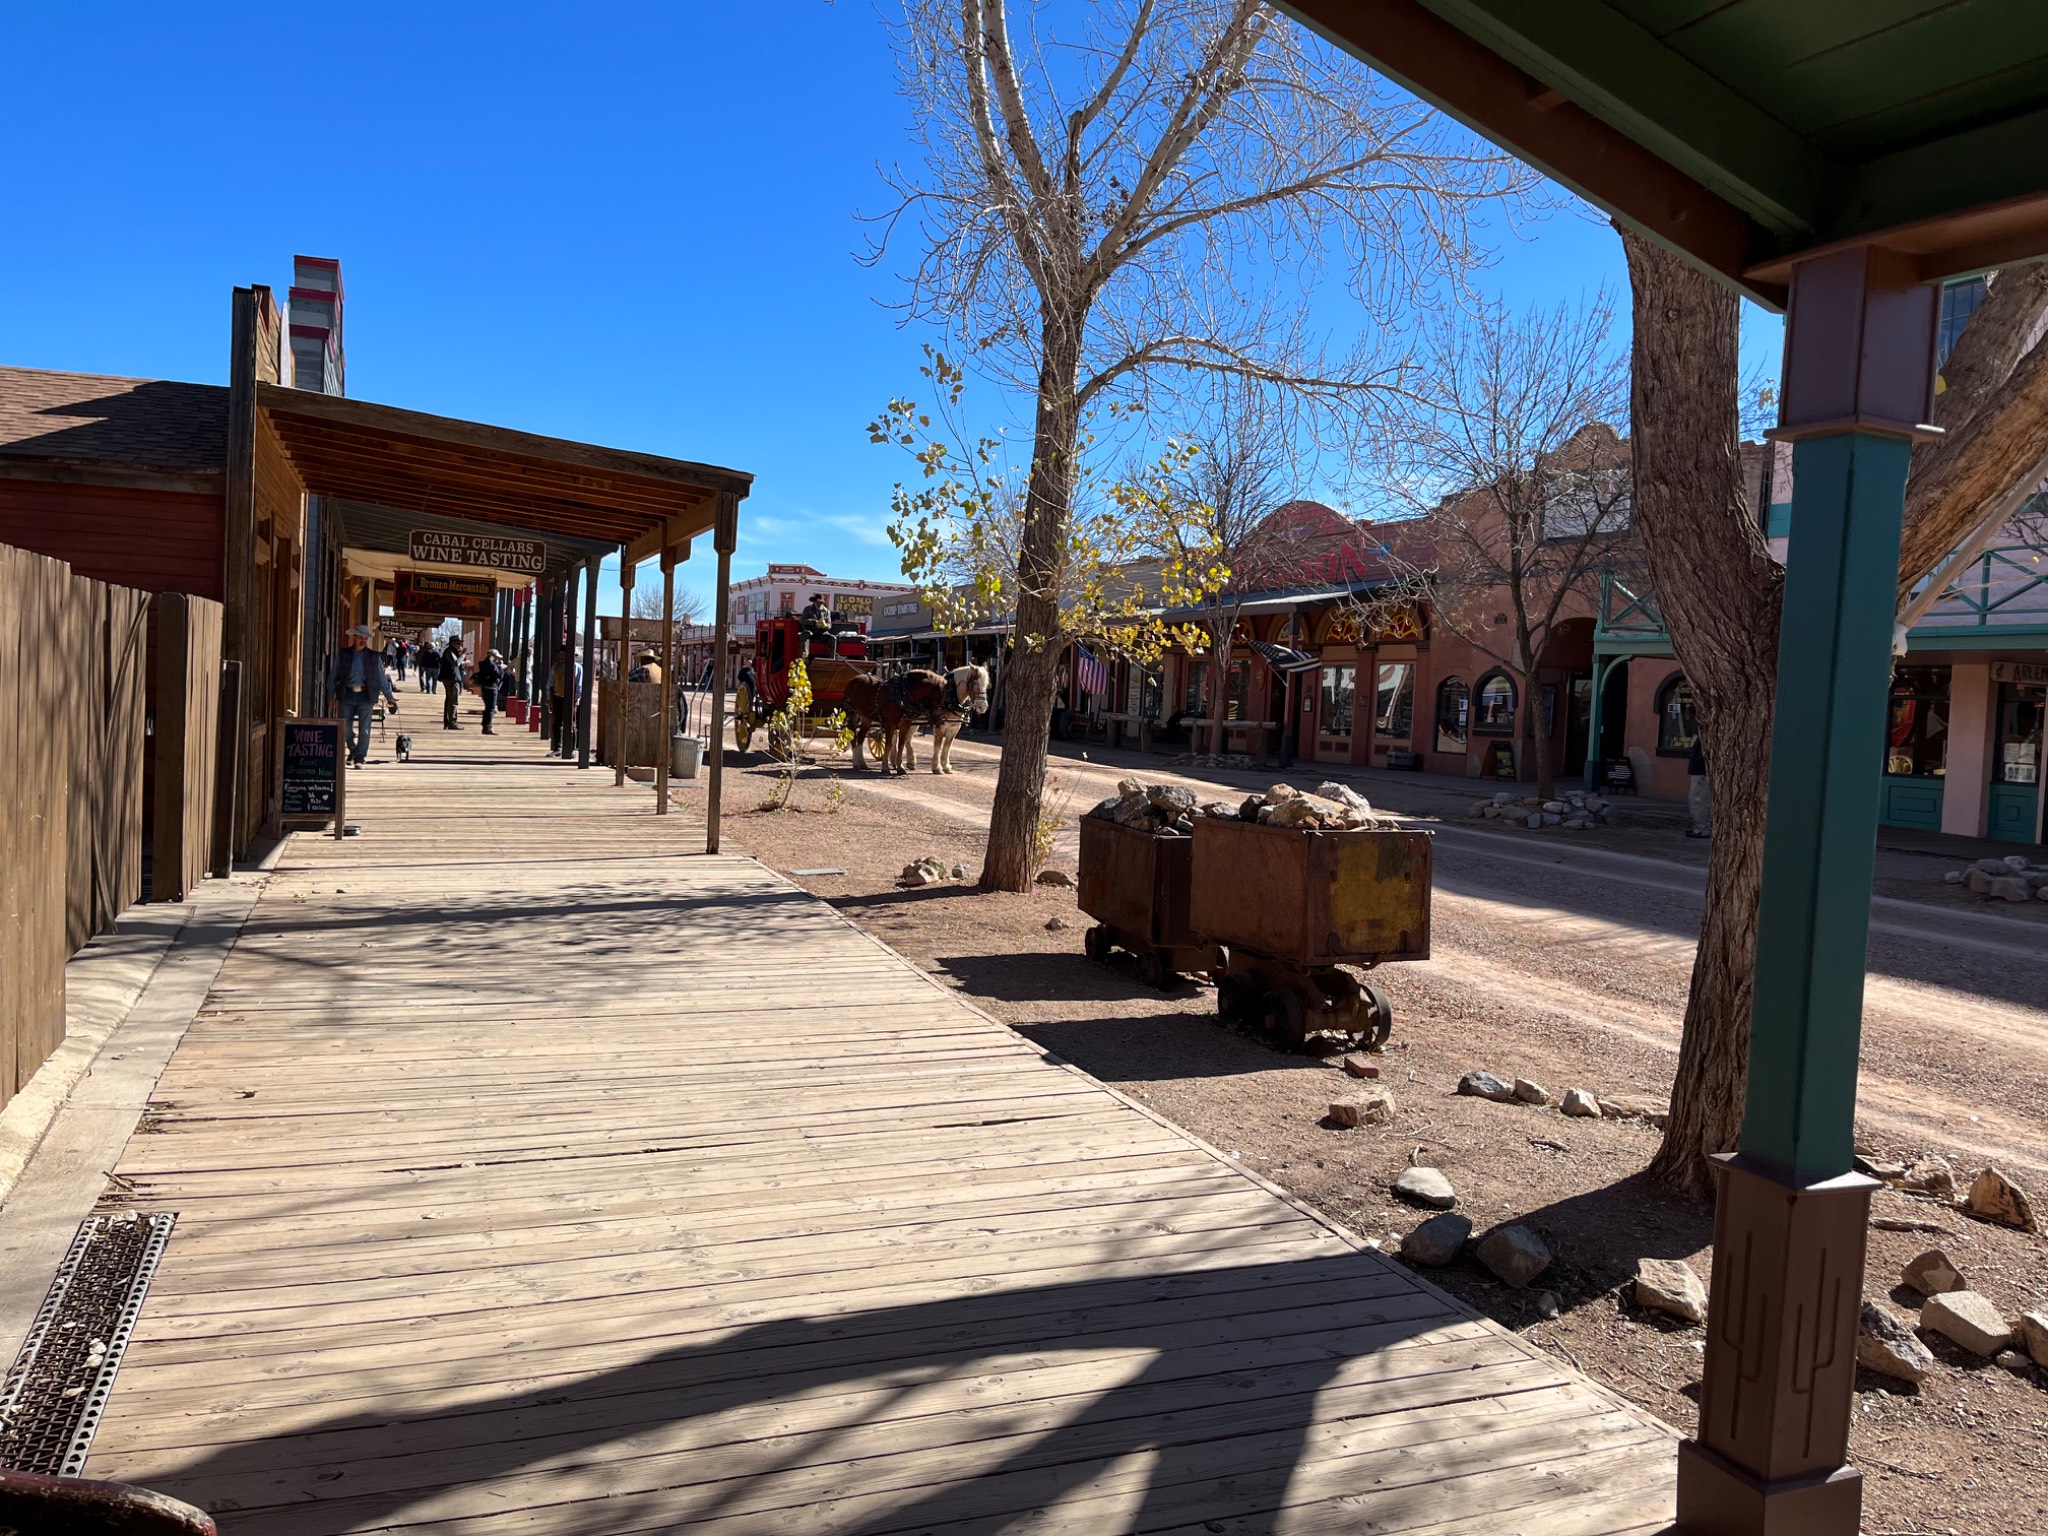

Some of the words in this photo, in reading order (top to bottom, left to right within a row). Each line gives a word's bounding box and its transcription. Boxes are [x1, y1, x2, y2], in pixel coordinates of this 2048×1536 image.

[423, 532, 469, 548] CABAL
[472, 537, 534, 554] CELLARS
[412, 545, 462, 562] WINE
[467, 550, 543, 570] TASTING
[420, 577, 448, 590] Bronco
[449, 580, 490, 594] Mercantile
[837, 595, 872, 604] LONG
[836, 603, 873, 614] RESTA
[294, 729, 323, 743] WINE
[286, 743, 334, 758] TASTING
